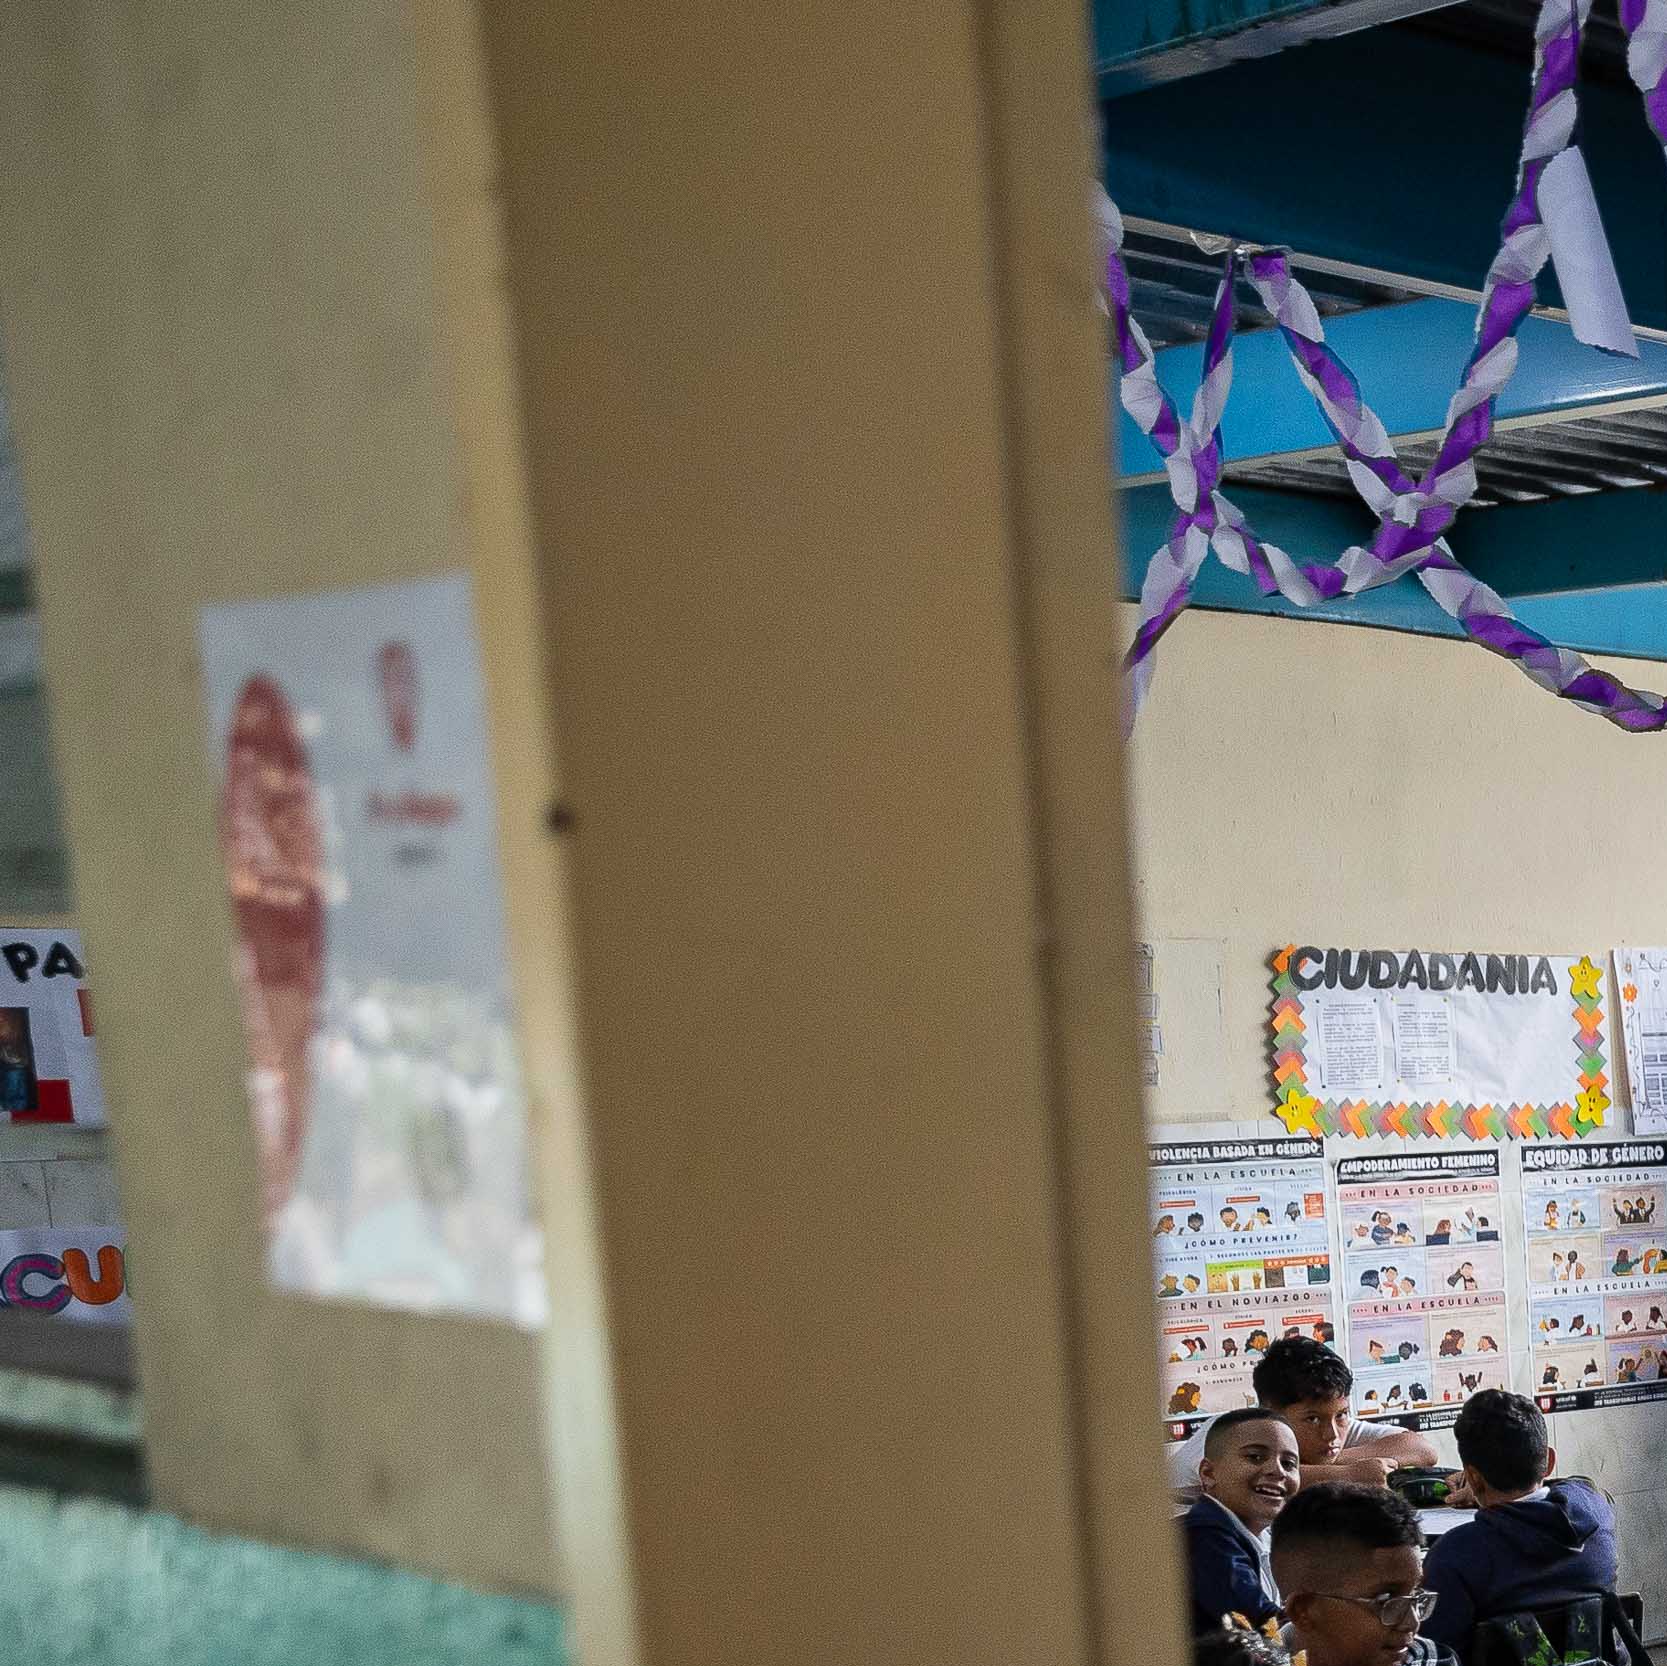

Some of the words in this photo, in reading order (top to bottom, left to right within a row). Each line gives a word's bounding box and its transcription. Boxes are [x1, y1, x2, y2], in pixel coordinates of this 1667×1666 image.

[1289, 946, 1558, 996] CIUDADANIA
[1149, 1146, 1211, 1162] VIOLENCIA
[1212, 1145, 1256, 1159] BASADA
[1258, 1143, 1273, 1156] EN
[1276, 1140, 1318, 1155] GÉNERO
[1525, 1149, 1588, 1168] EQUIDAD
[1591, 1147, 1608, 1161] DE
[1612, 1143, 1665, 1163] GÉNERO
[1340, 1157, 1440, 1174] EMPODERAMIENTO
[1441, 1153, 1496, 1169] FEMENINO
[1177, 1171, 1194, 1182] EN
[1204, 1170, 1220, 1180] LA
[1230, 1168, 1296, 1179] ESCUELA
[1543, 1176, 1557, 1185] EN
[1565, 1175, 1579, 1184] LA
[1587, 1173, 1650, 1184] SOCIEDAD
[1360, 1189, 1376, 1198] EN
[1385, 1187, 1400, 1197] LA
[1409, 1184, 1479, 1195] SOCIEDAD
[1553, 1287, 1568, 1295] EN
[1575, 1285, 1588, 1294] LA
[1596, 1281, 1650, 1292] ESCUELA
[1180, 1302, 1198, 1311] EN
[1208, 1300, 1222, 1309] EL
[1373, 1305, 1389, 1314] EN
[1397, 1303, 1413, 1312] LA
[1421, 1296, 1480, 1309] ESCUELA
